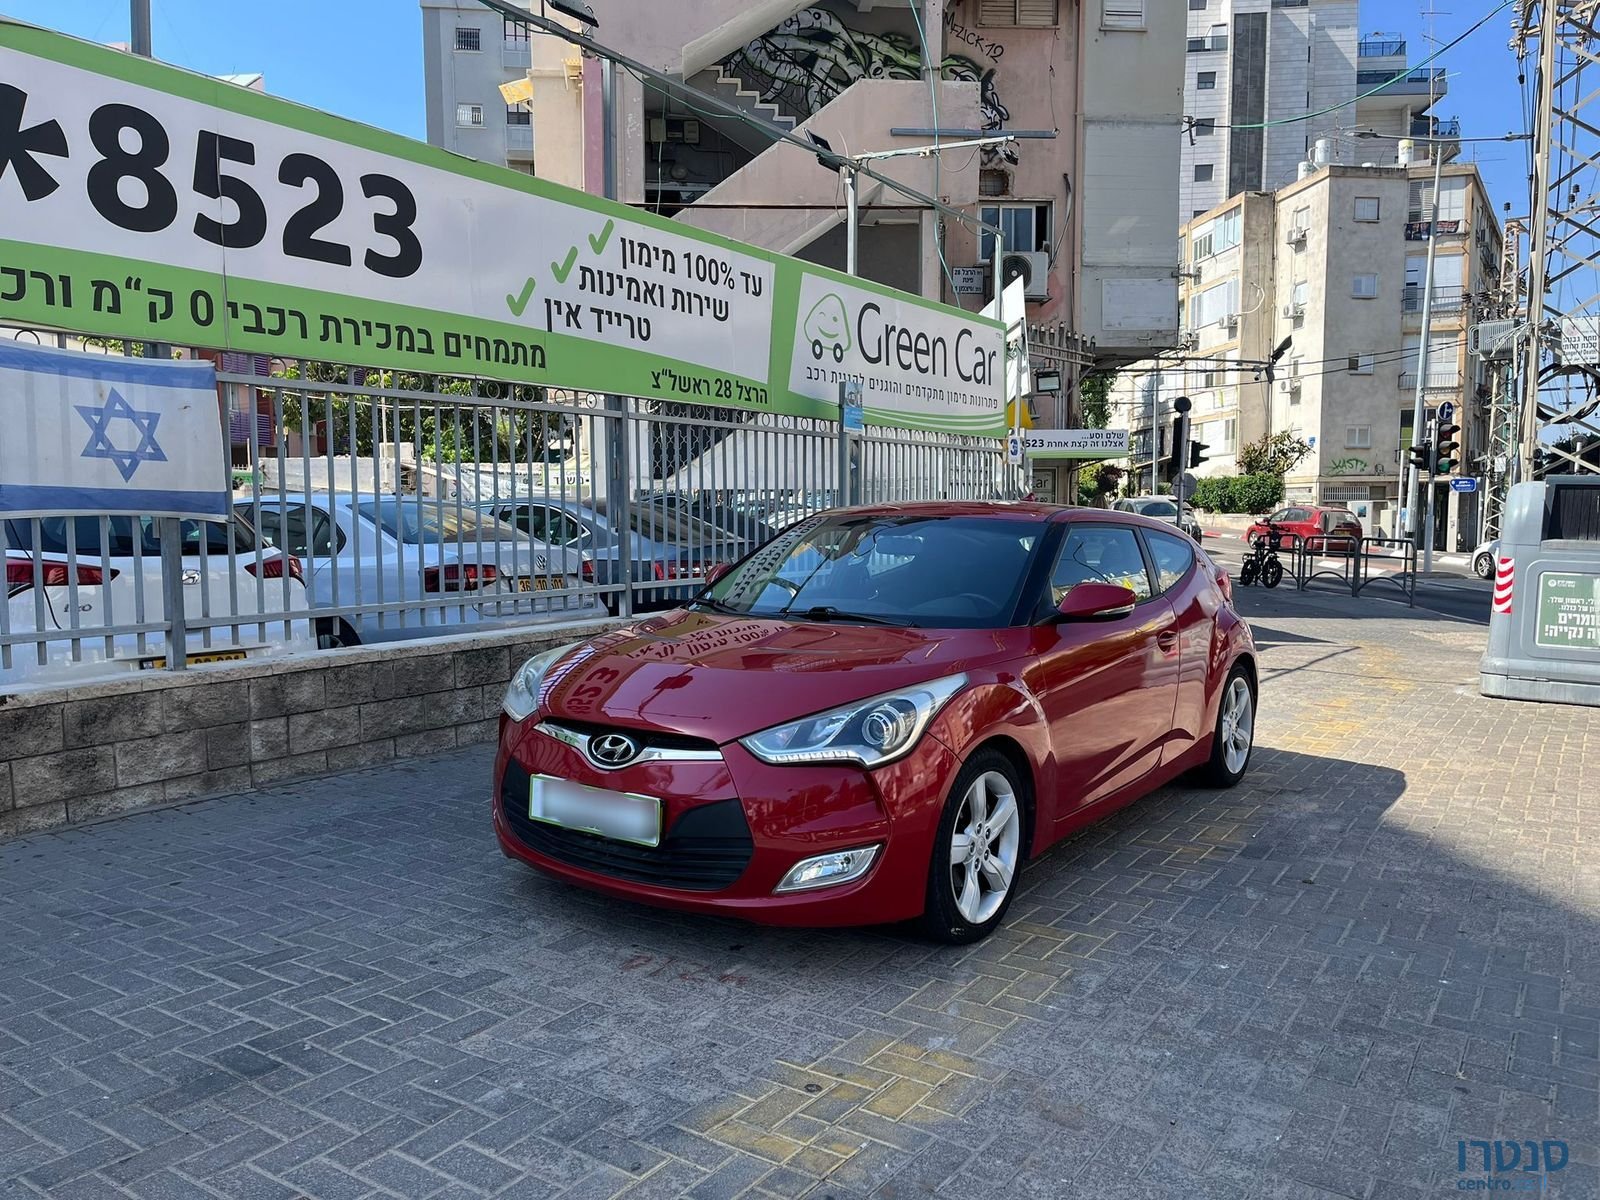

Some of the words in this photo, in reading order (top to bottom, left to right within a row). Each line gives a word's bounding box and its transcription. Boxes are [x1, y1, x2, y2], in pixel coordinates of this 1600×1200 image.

[620, 237, 676, 274] מימון
[684, 252, 735, 290] 100%
[578, 265, 665, 308] ואמינות
[740, 271, 762, 297] עד
[190, 289, 214, 327] 0
[544, 298, 583, 333] אין
[671, 287, 729, 322] שירות
[227, 301, 308, 339] רכבי
[590, 306, 651, 341] טרייד
[319, 314, 435, 355] במכירת
[857, 302, 948, 377] Green
[955, 328, 997, 386] Car
[443, 331, 547, 369] מתמחים
[806, 366, 827, 381] רכב
[714, 378, 732, 399] 28
[735, 380, 768, 404] הרצל
[869, 377, 902, 394] והוגנים
[905, 383, 945, 401] מתקדמים
[947, 390, 967, 406] מימון
[969, 394, 999, 409] פתרונות
[1022, 439, 1044, 448] 523
[1047, 440, 1069, 448] אחרת
[1071, 440, 1088, 449] קצת
[1089, 440, 1099, 448] זה
[1101, 440, 1124, 448] אצלנו
[1105, 431, 1124, 439] שלם
[1544, 624, 1584, 639] נקייה!
